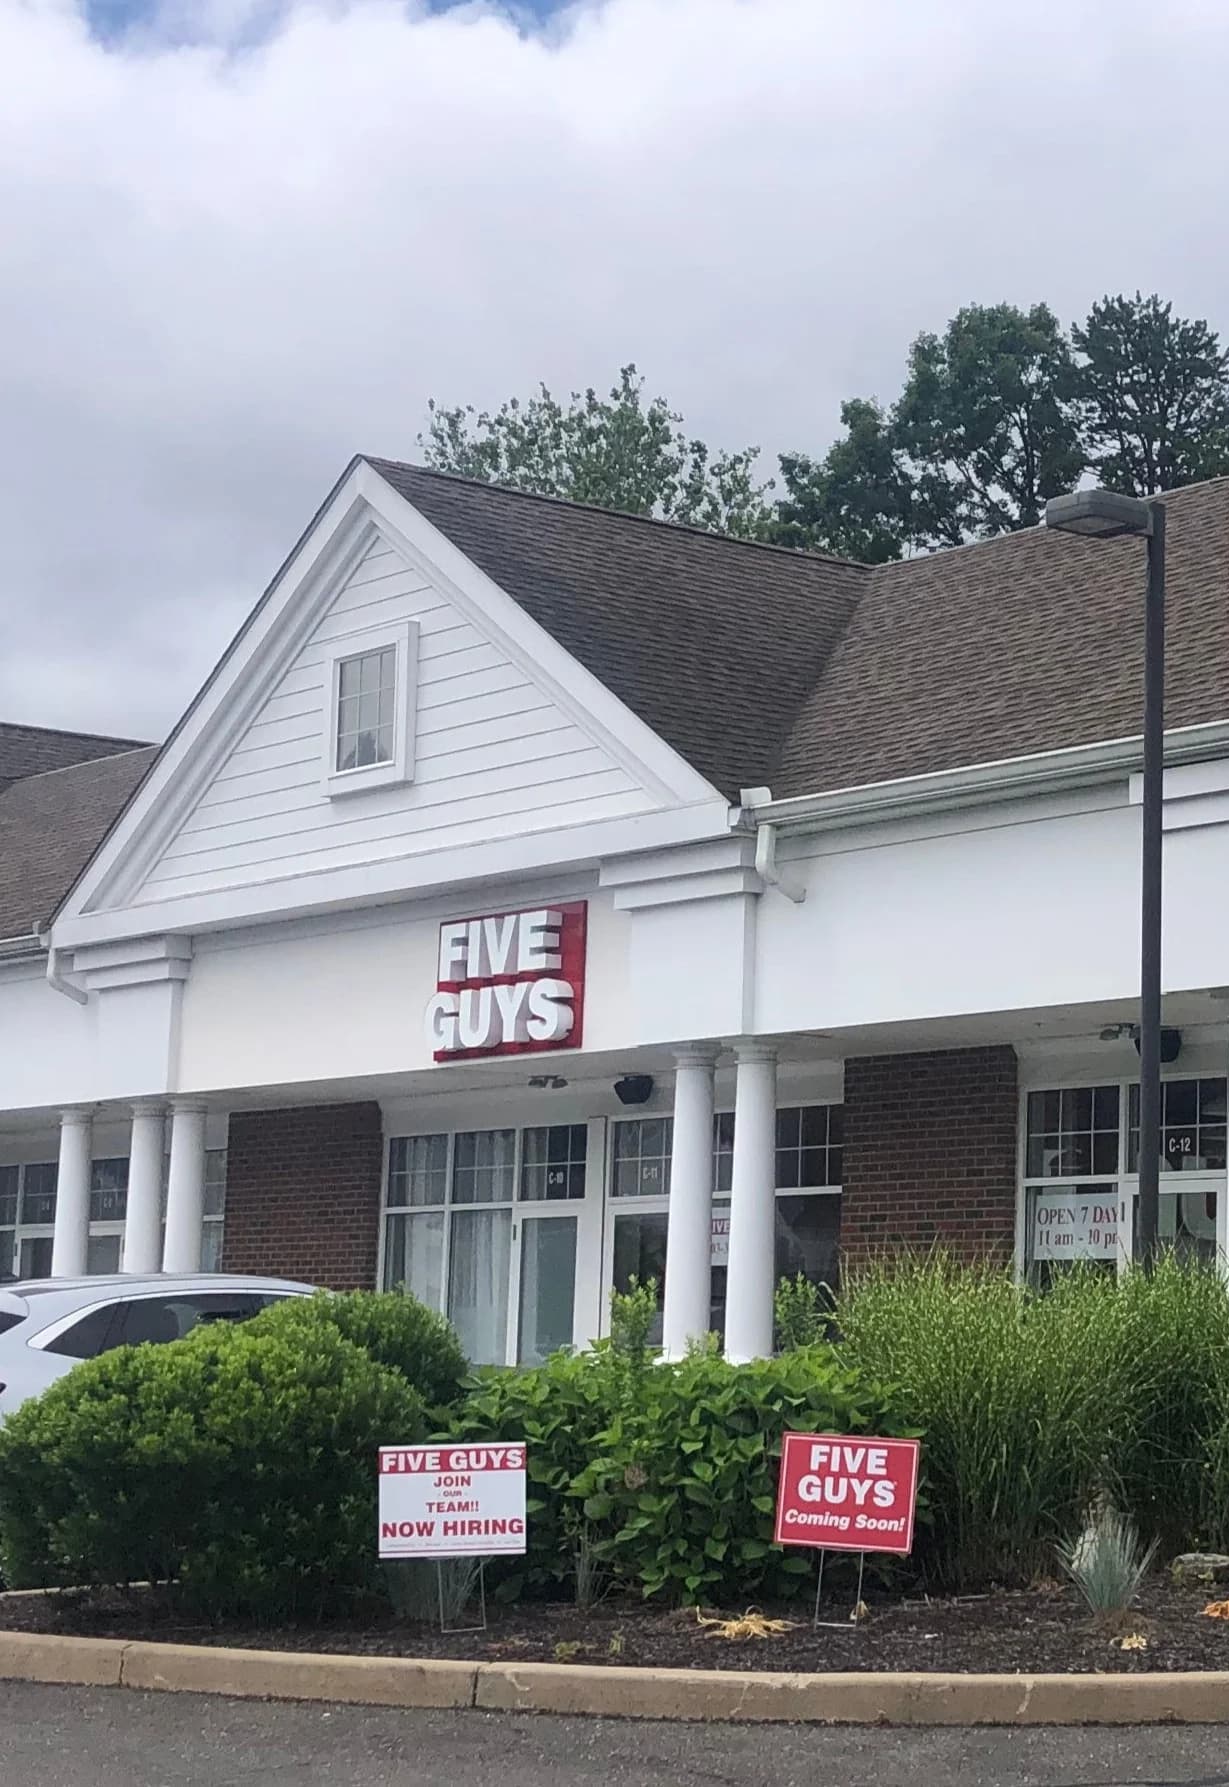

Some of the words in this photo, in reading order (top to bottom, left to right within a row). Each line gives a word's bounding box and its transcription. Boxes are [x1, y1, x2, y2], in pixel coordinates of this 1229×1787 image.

[439, 910, 562, 982] FIVE
[425, 978, 574, 1051] GUYS
[1169, 1137, 1191, 1152] C-12
[1038, 1207, 1075, 1225] OPEN
[1081, 1206, 1089, 1224] 7
[1093, 1206, 1118, 1223] DAY
[712, 1220, 730, 1232] IVE
[1040, 1230, 1049, 1246] 11
[1055, 1233, 1074, 1245] am
[1089, 1229, 1100, 1245] 10
[382, 1452, 440, 1472] FIVE
[449, 1449, 522, 1470] GUYS
[810, 1445, 887, 1475] FIVE
[434, 1476, 471, 1487] JOIN
[798, 1475, 895, 1507] GUYS
[426, 1501, 479, 1513] TEAM!!
[382, 1522, 435, 1537] NOW
[443, 1519, 524, 1536] HIRING
[785, 1509, 850, 1530] Coming
[855, 1514, 905, 1531] Soon!
